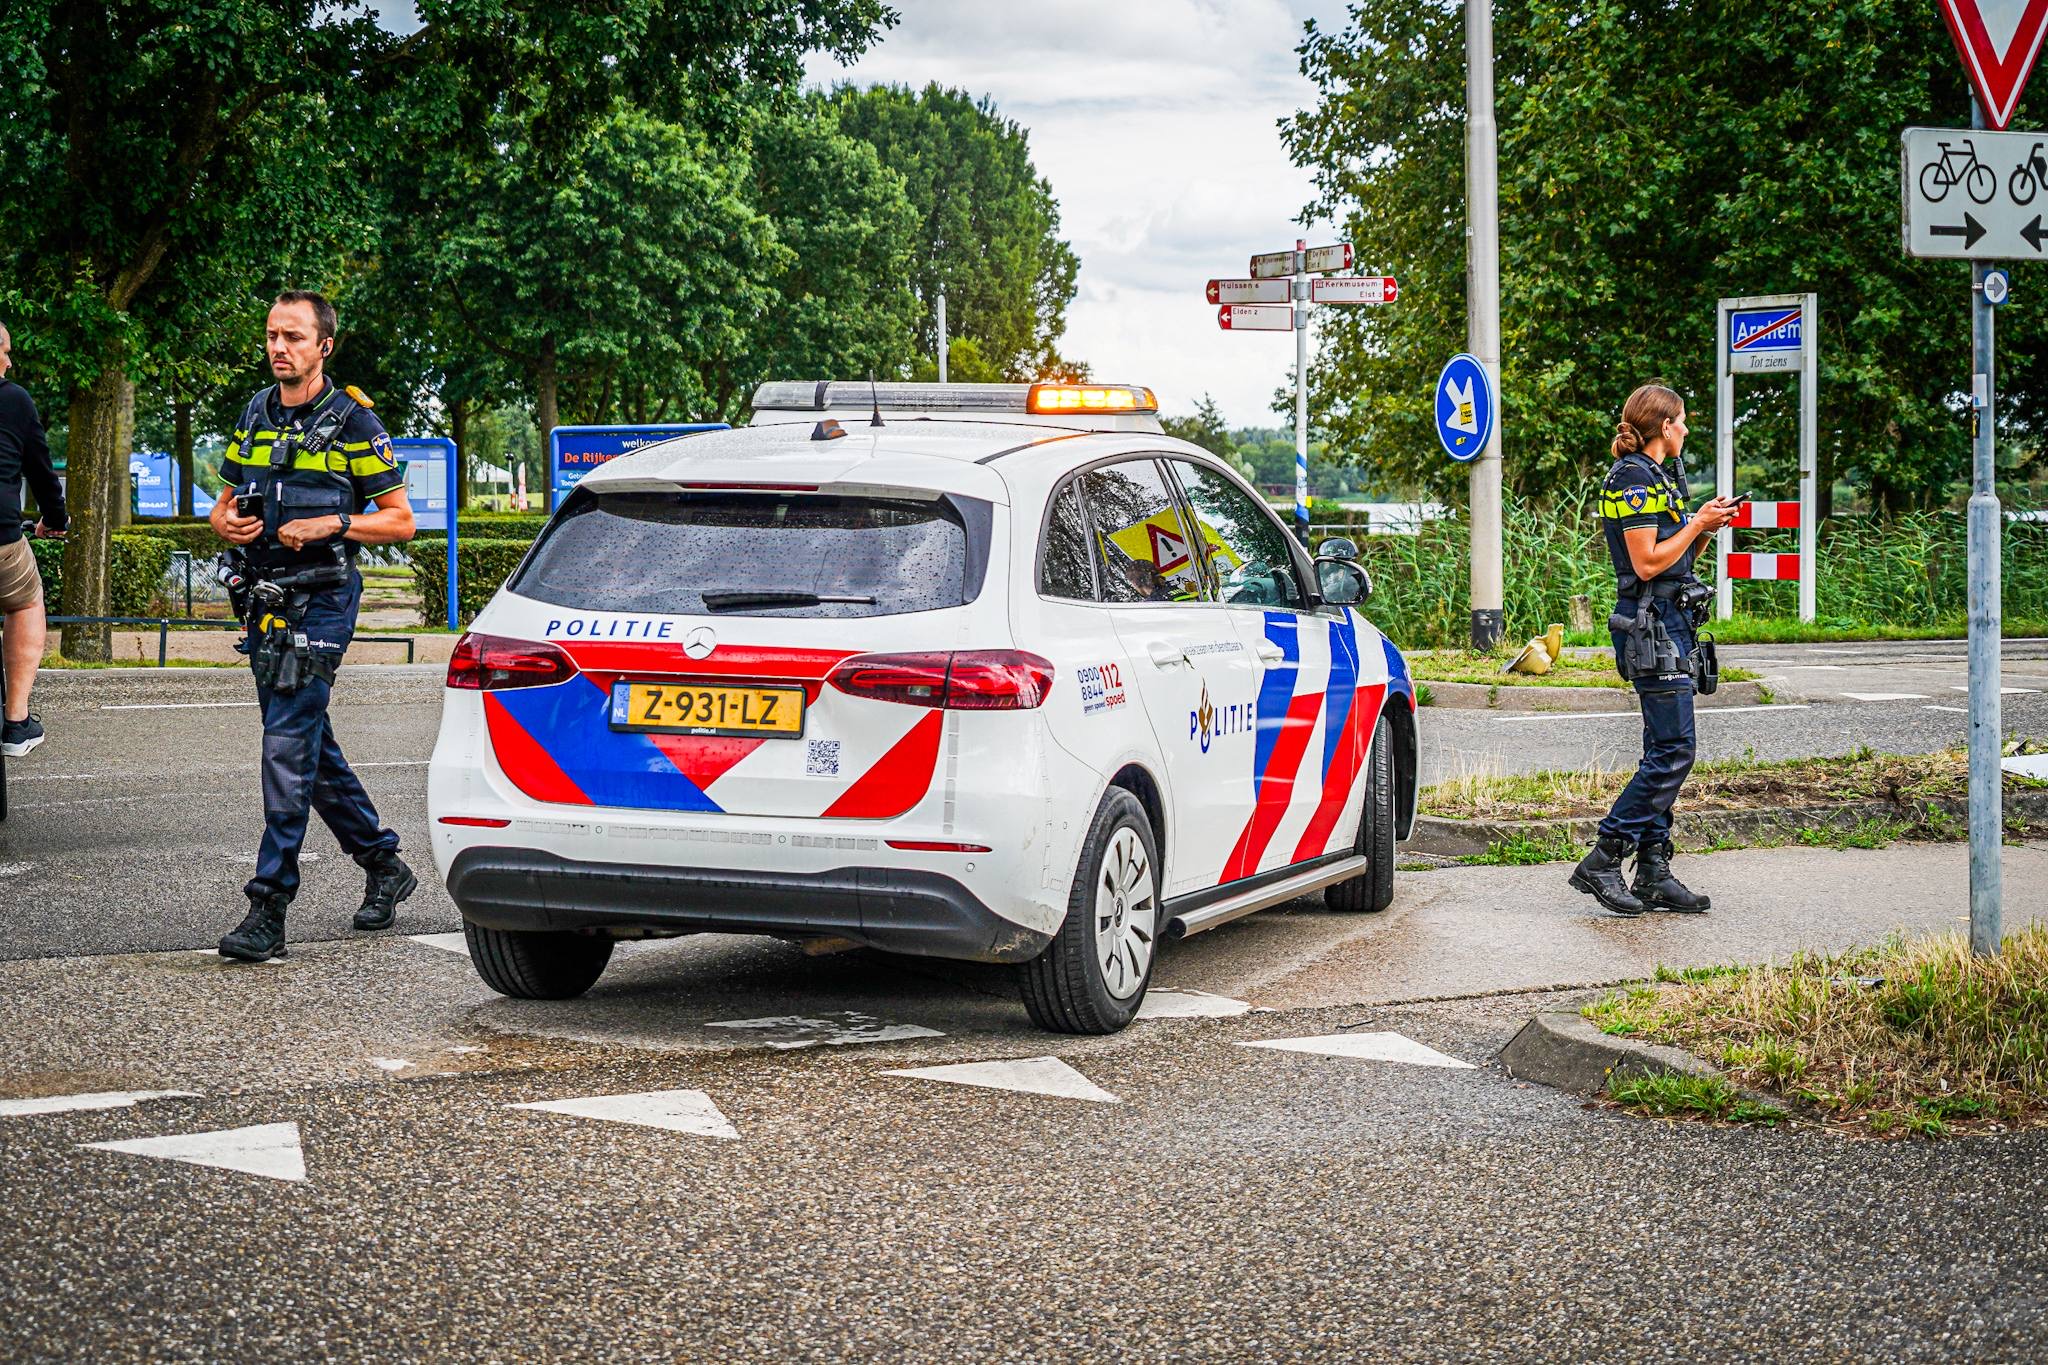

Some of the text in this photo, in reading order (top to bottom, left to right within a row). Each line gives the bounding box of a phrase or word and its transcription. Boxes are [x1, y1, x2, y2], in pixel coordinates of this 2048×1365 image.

[1736, 320, 1801, 341] Arnhem
[1750, 355, 1787, 368] Tot ziens
[564, 452, 580, 463] De
[545, 619, 674, 638] POLITIE
[1077, 666, 1100, 684] 0900
[1099, 663, 1122, 689] 112
[1081, 683, 1103, 701] 8844
[1105, 689, 1126, 709] spoed
[613, 689, 779, 725] NL Z-931-LZ
[1190, 700, 1253, 754] POLITIE
